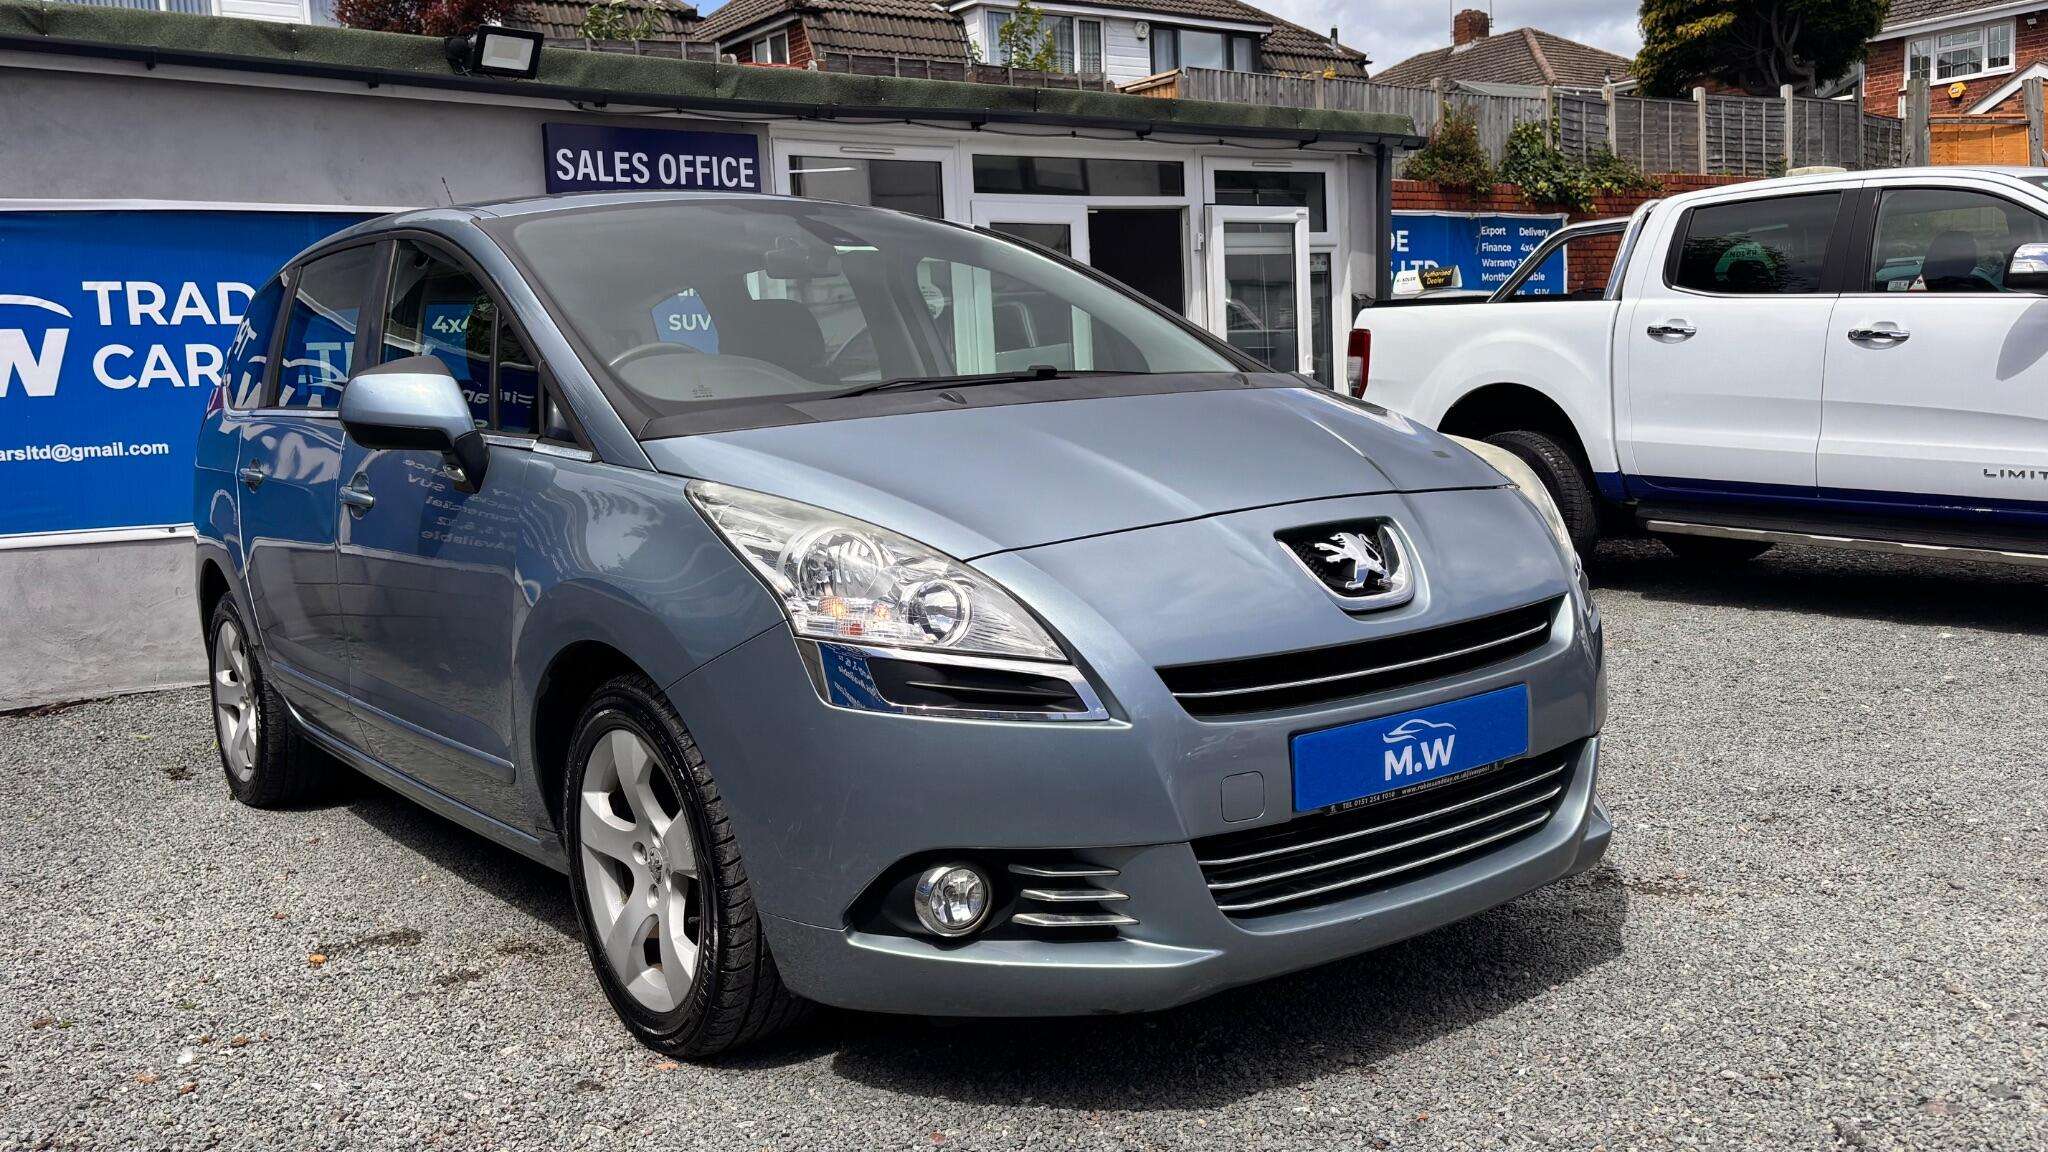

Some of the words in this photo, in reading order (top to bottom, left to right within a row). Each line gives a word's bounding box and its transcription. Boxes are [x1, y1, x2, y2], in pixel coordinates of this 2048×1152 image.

[556, 148, 650, 184] SALES
[658, 153, 755, 188] OFFICE
[1481, 226, 1506, 237] Export
[1519, 227, 1549, 238] Delivery
[1481, 242, 1512, 252] Finance
[1520, 243, 1534, 251] 4x4
[1482, 258, 1516, 268] Warranty
[668, 314, 711, 331] SUV
[92, 343, 231, 390] CAR
[1384, 735, 1455, 781] M.W
